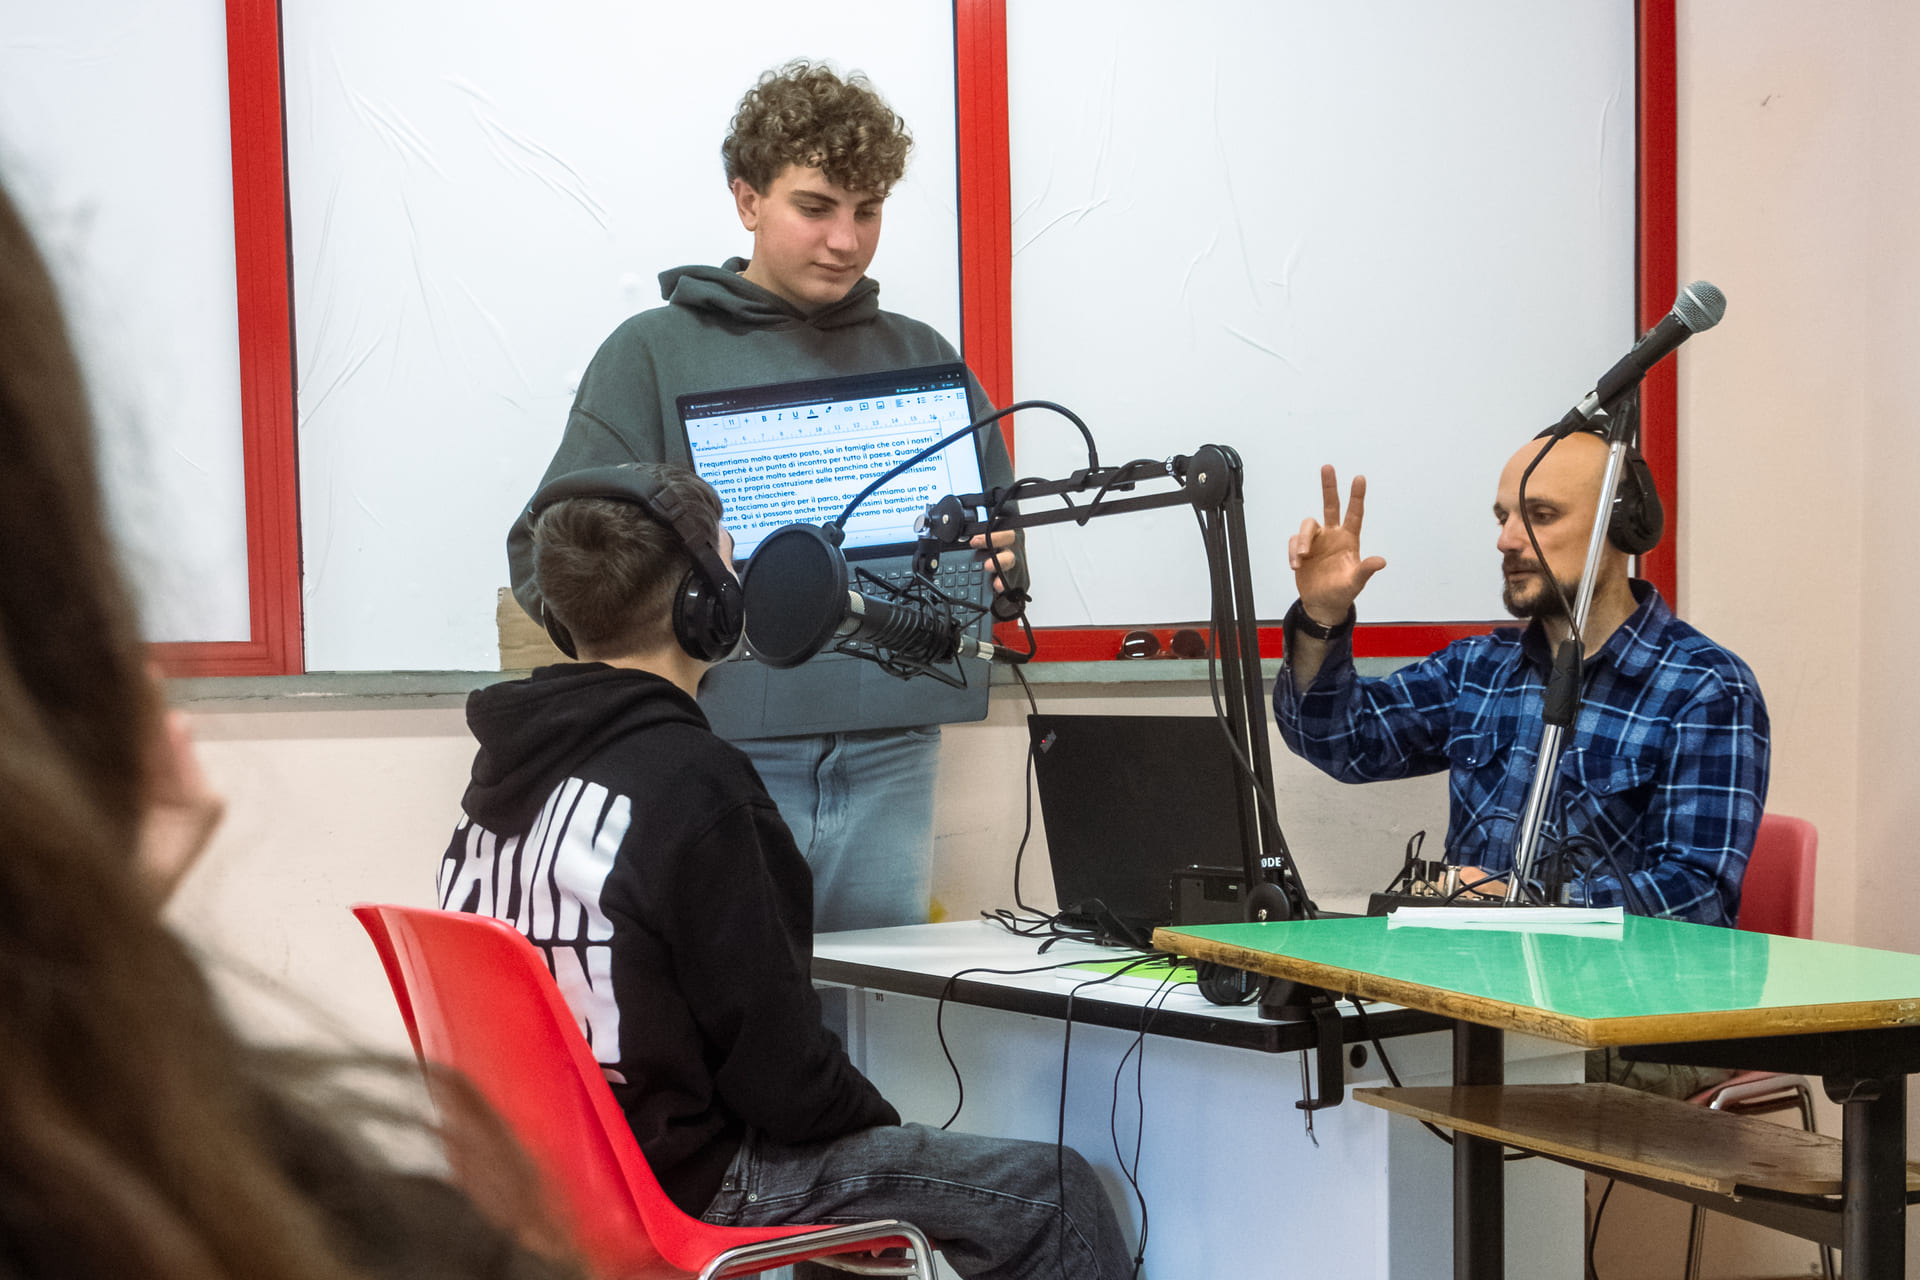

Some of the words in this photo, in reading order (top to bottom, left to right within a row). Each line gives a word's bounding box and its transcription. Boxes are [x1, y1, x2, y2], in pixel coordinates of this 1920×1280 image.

[699, 458, 749, 470] Frequentiamo
[751, 455, 771, 463] molto
[773, 452, 797, 462] questo
[800, 450, 822, 459] posto,
[823, 447, 834, 455] sia
[844, 442, 875, 453] famiglia
[876, 441, 890, 449] che
[911, 436, 933, 445] nostri
[701, 470, 721, 478] amici
[766, 463, 787, 473] punto
[797, 458, 828, 467] incontro
[829, 456, 841, 465] per
[869, 451, 893, 461] paese.
[894, 448, 924, 456] Quando
[708, 477, 735, 487] ndiamo
[744, 474, 764, 484] piace
[766, 471, 787, 480] molto
[788, 469, 814, 478] sederci
[816, 466, 833, 475] sulla
[834, 462, 868, 474] panchina
[870, 460, 883, 468] che
[884, 458, 891, 466] si
[720, 487, 736, 495] vera
[744, 482, 770, 493] propria
[772, 478, 813, 489] costruzione
[815, 476, 832, 484] delle
[834, 474, 859, 483] terme,
[903, 464, 937, 474] oltissimo
[735, 502, 769, 512] facciamo
[781, 499, 796, 509] giro
[797, 498, 809, 506] per
[817, 495, 840, 504] parco,
[842, 493, 859, 501] dov
[870, 488, 905, 497] ermiamo
[918, 484, 930, 493] po'
[738, 493, 753, 502] fare
[754, 489, 797, 501] chiacchiere.
[740, 512, 754, 521] Qui
[755, 511, 762, 519] si
[763, 508, 793, 519] possono
[794, 506, 816, 515] anche
[817, 503, 844, 512] trovare
[884, 496, 914, 505] bambini
[916, 494, 929, 502] che
[751, 521, 758, 529] si
[758, 518, 794, 529] divertono
[795, 515, 822, 525] proprio
[823, 512, 841, 521] com
[882, 506, 894, 514] noi
[895, 504, 925, 514] qualche
[1261, 856, 1281, 868] ØDE
